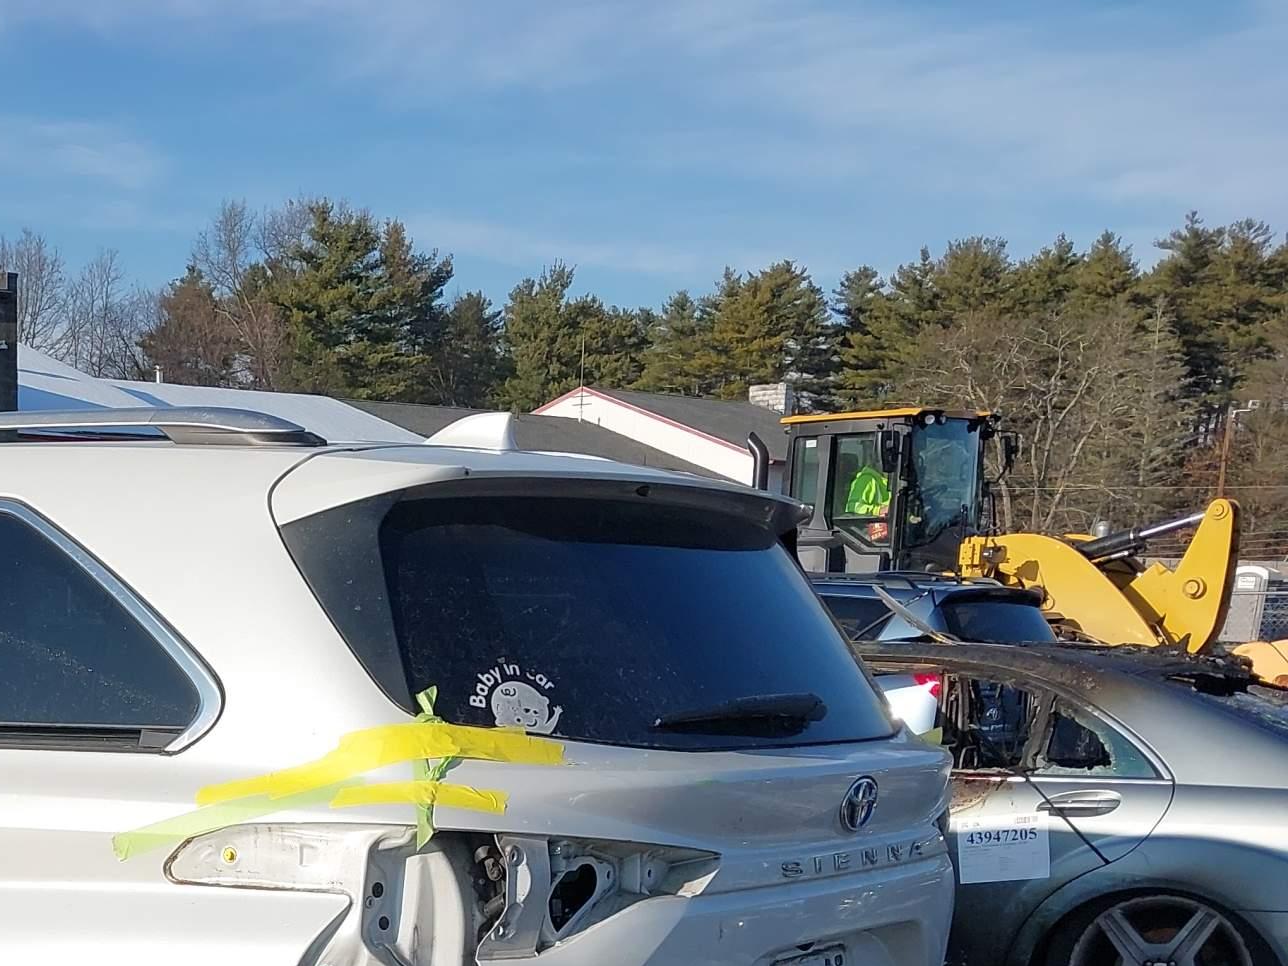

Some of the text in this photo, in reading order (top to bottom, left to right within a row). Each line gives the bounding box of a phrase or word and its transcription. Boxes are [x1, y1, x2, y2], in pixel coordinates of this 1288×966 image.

[469, 666, 502, 708] Baby
[498, 657, 520, 676] in
[966, 828, 1038, 845] 43947205
